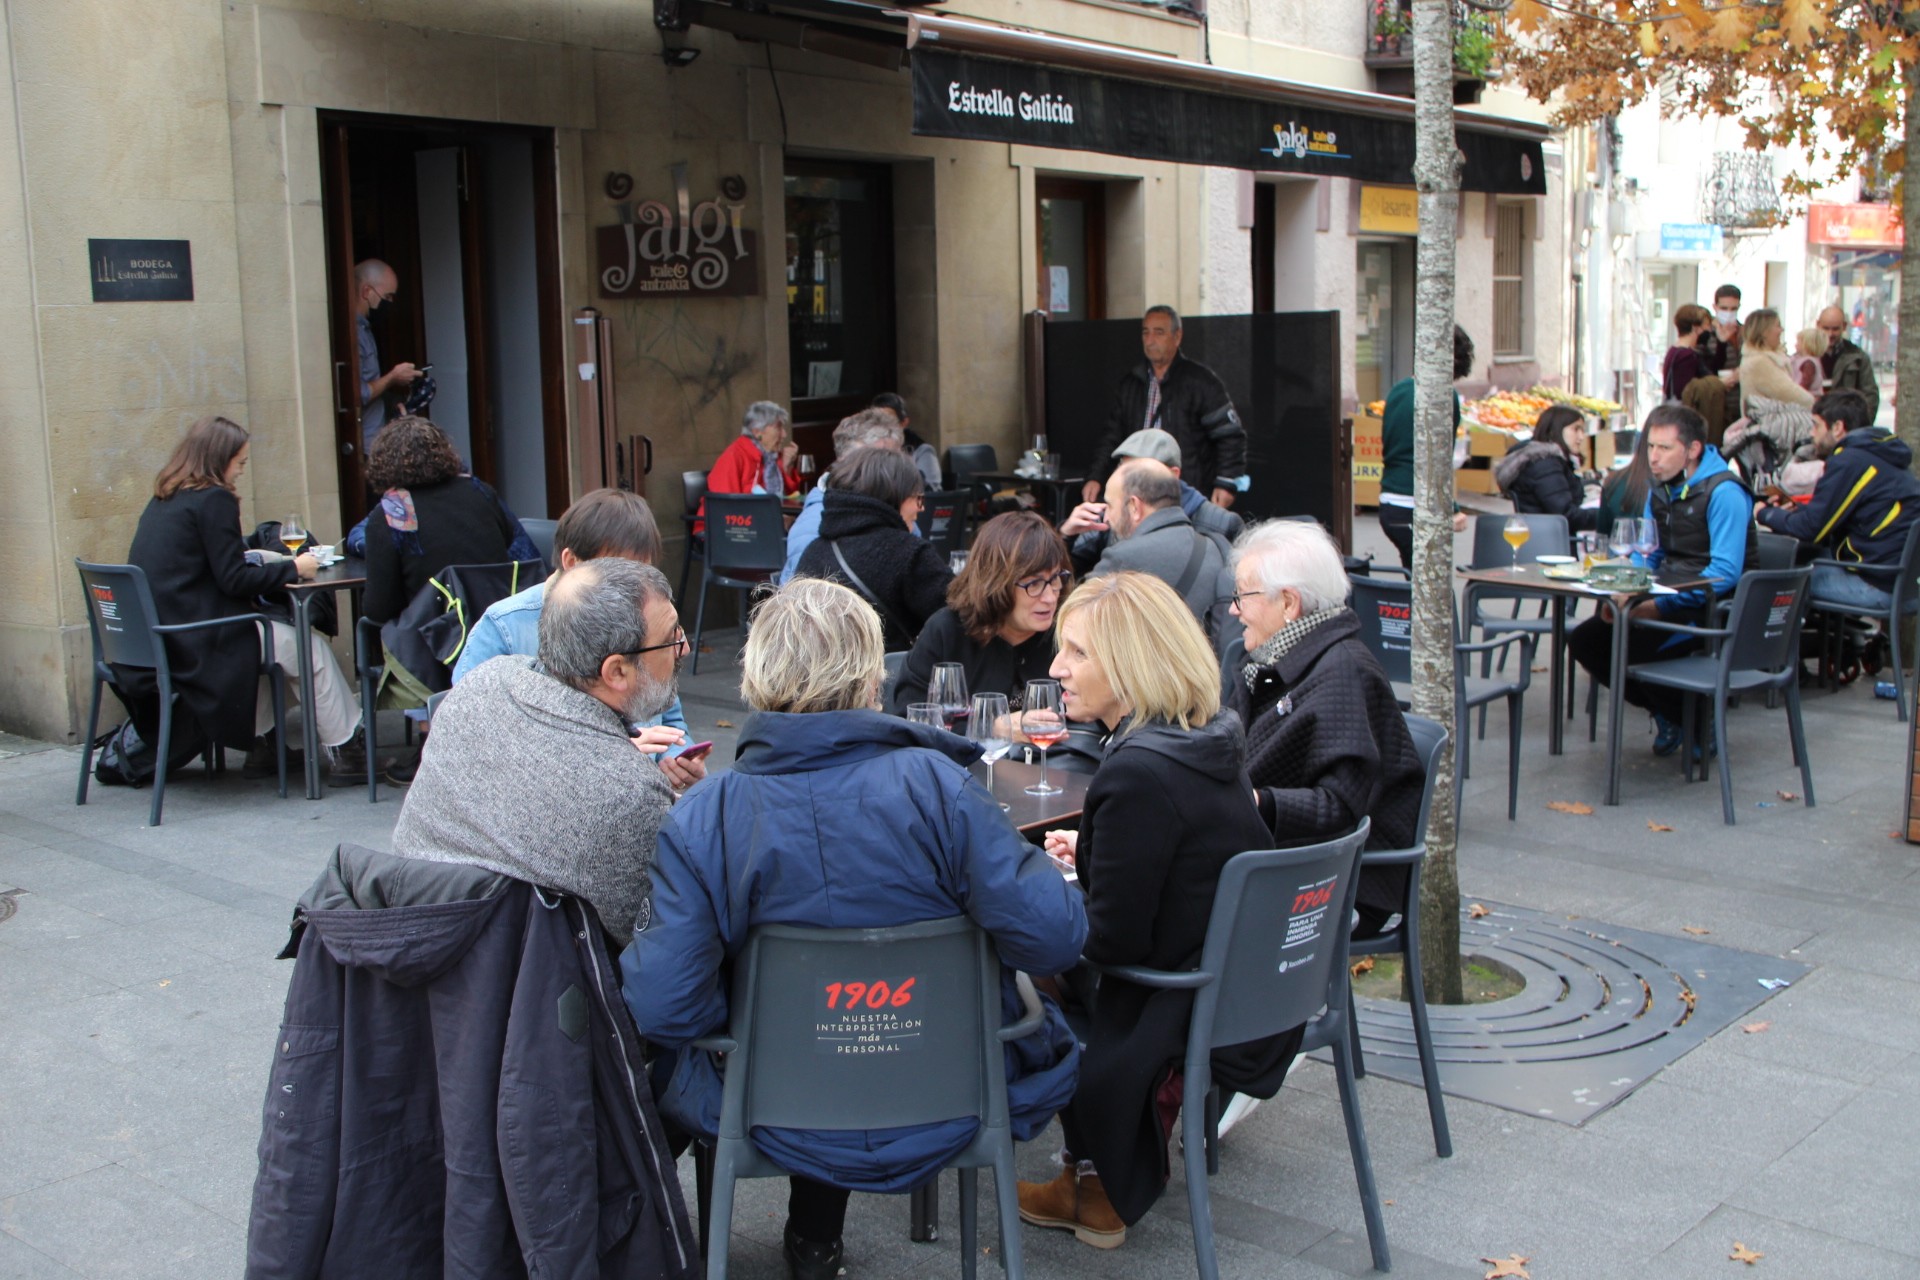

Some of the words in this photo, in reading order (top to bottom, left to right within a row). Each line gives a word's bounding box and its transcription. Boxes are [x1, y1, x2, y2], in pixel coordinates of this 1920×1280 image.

[948, 81, 1014, 117] Estrella
[1019, 91, 1074, 124] Galicia
[1272, 121, 1309, 158] jalgi
[602, 161, 749, 293] jalgi
[130, 260, 172, 269] BODEGA
[118, 271, 149, 280] Estrella
[725, 515, 752, 526] 1906
[1378, 605, 1410, 619] 1906
[1291, 881, 1336, 913] 1906
[1289, 918, 1309, 929] PARA
[1310, 912, 1324, 923] UNA
[1287, 921, 1317, 936] INMENSA
[825, 976, 916, 1010] 1906
[842, 1013, 897, 1023] NUESTRA
[816, 1019, 922, 1032] INTERPRETACIÓN
[858, 1033, 880, 1043] más
[837, 1043, 900, 1053] PERSONAL
